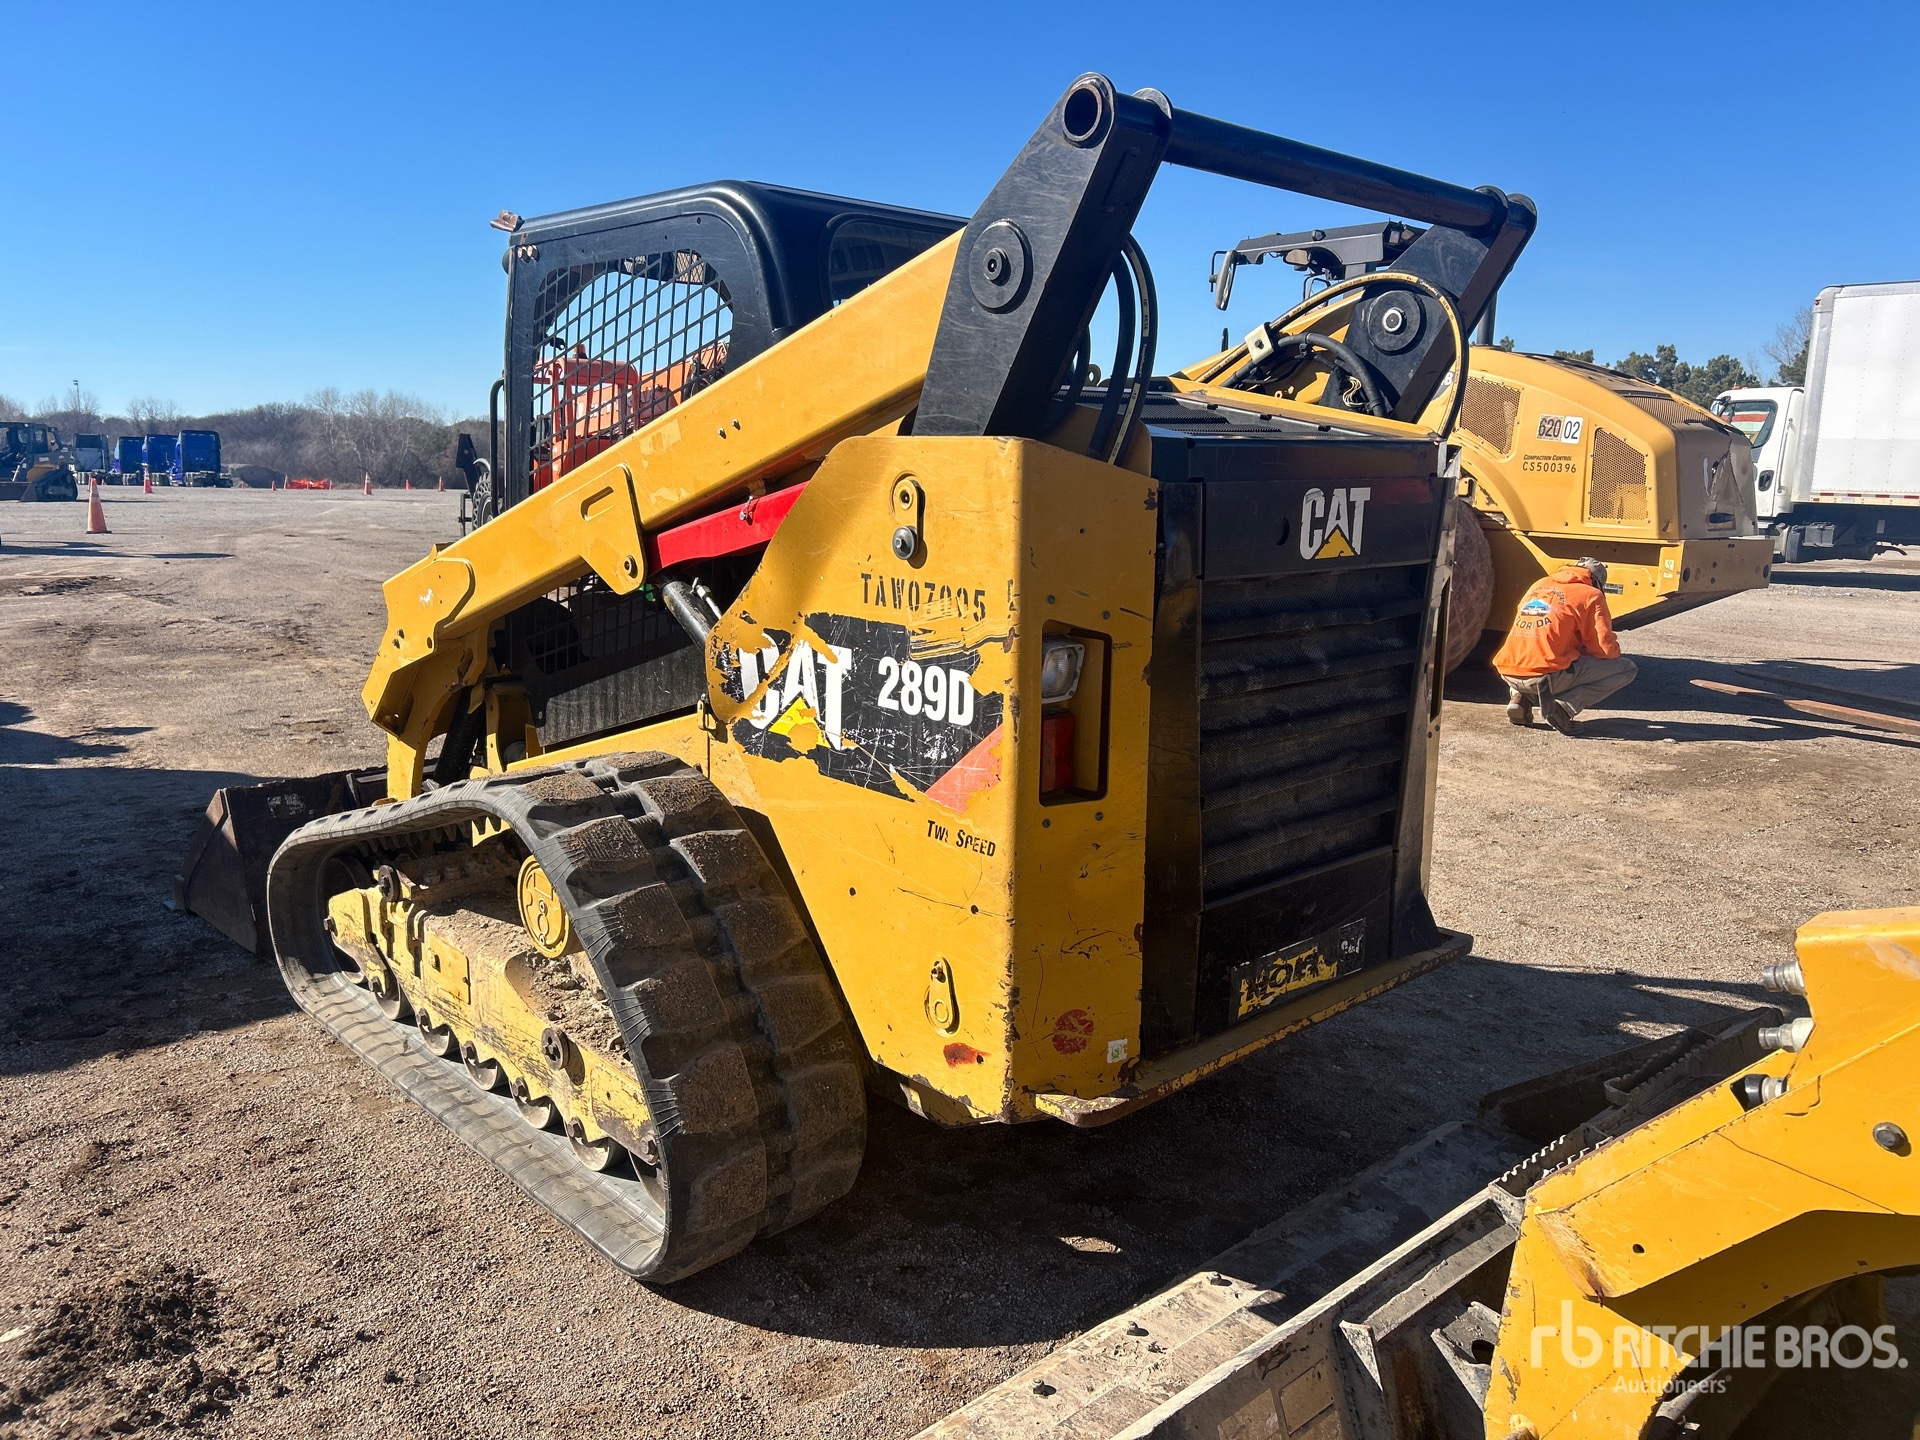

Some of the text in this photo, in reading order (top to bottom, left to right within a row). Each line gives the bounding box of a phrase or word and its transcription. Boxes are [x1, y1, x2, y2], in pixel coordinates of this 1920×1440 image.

[1538, 418, 1581, 440] 620 02
[1522, 461, 1577, 474] CS500396
[1299, 486, 1372, 560] CAT
[738, 632, 975, 751] CAT 289D
